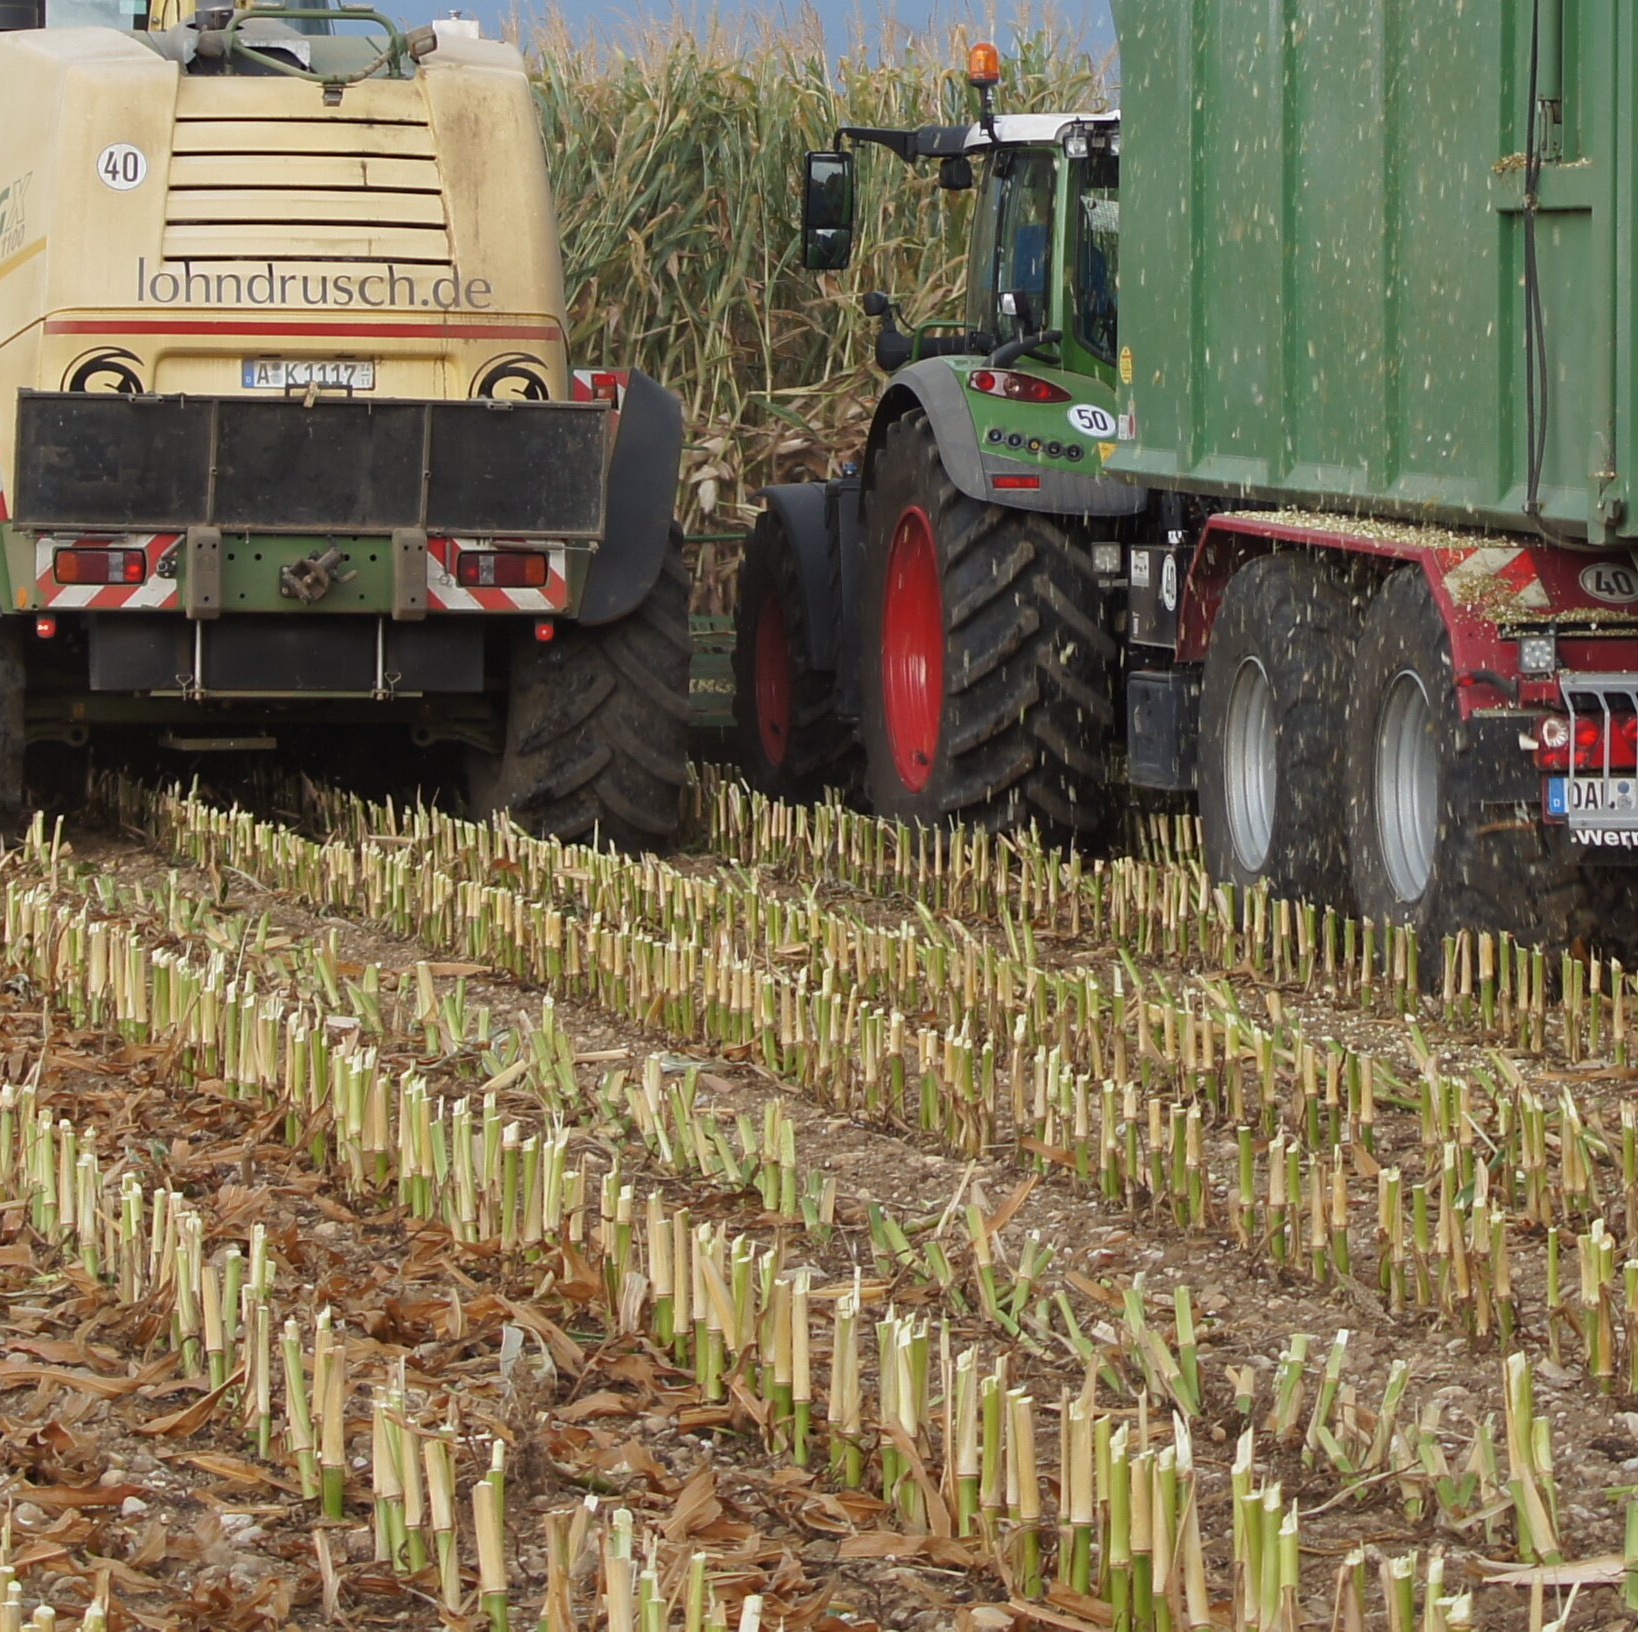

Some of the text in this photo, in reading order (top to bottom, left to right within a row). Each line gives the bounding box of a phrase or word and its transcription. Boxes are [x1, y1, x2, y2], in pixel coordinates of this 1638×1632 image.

[102, 150, 142, 184] 40
[0, 223, 26, 258] 1100
[136, 256, 493, 310] lohndrusch.de
[256, 362, 270, 385] A
[1076, 408, 1109, 432] 50
[1594, 572, 1635, 597] 40
